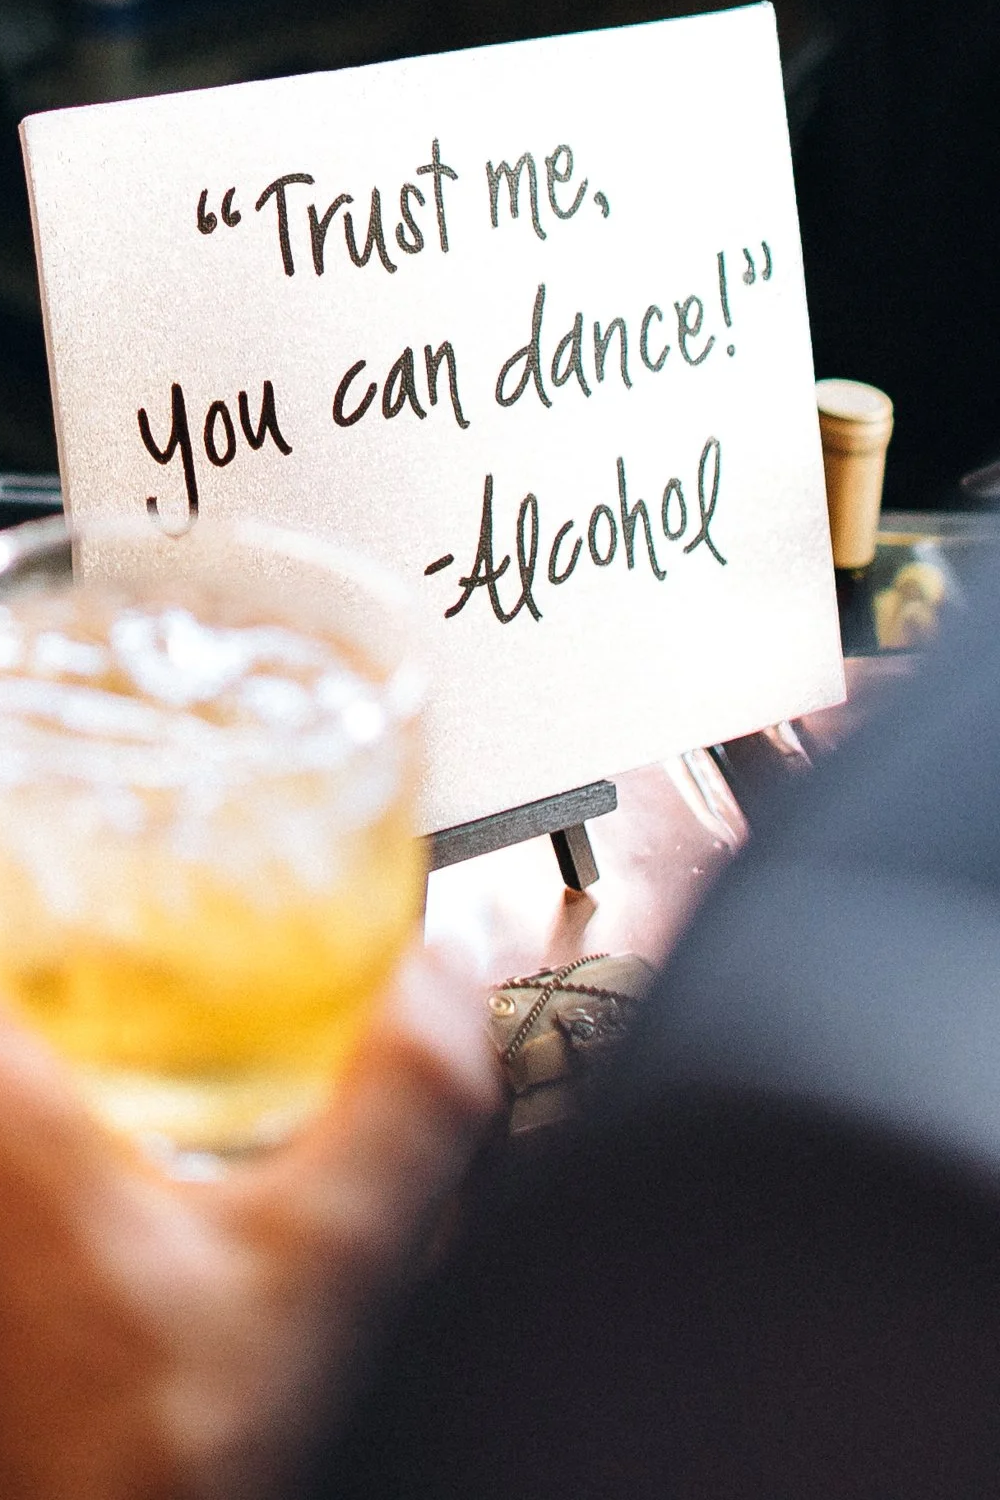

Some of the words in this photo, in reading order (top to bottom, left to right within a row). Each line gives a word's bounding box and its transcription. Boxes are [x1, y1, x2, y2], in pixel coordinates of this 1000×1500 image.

[196, 137, 459, 278] “Trust
[485, 142, 611, 241] me,
[136, 379, 294, 536] you
[332, 340, 471, 430] can
[494, 240, 775, 409] dance!”
[423, 436, 728, 625] -Alcohol
